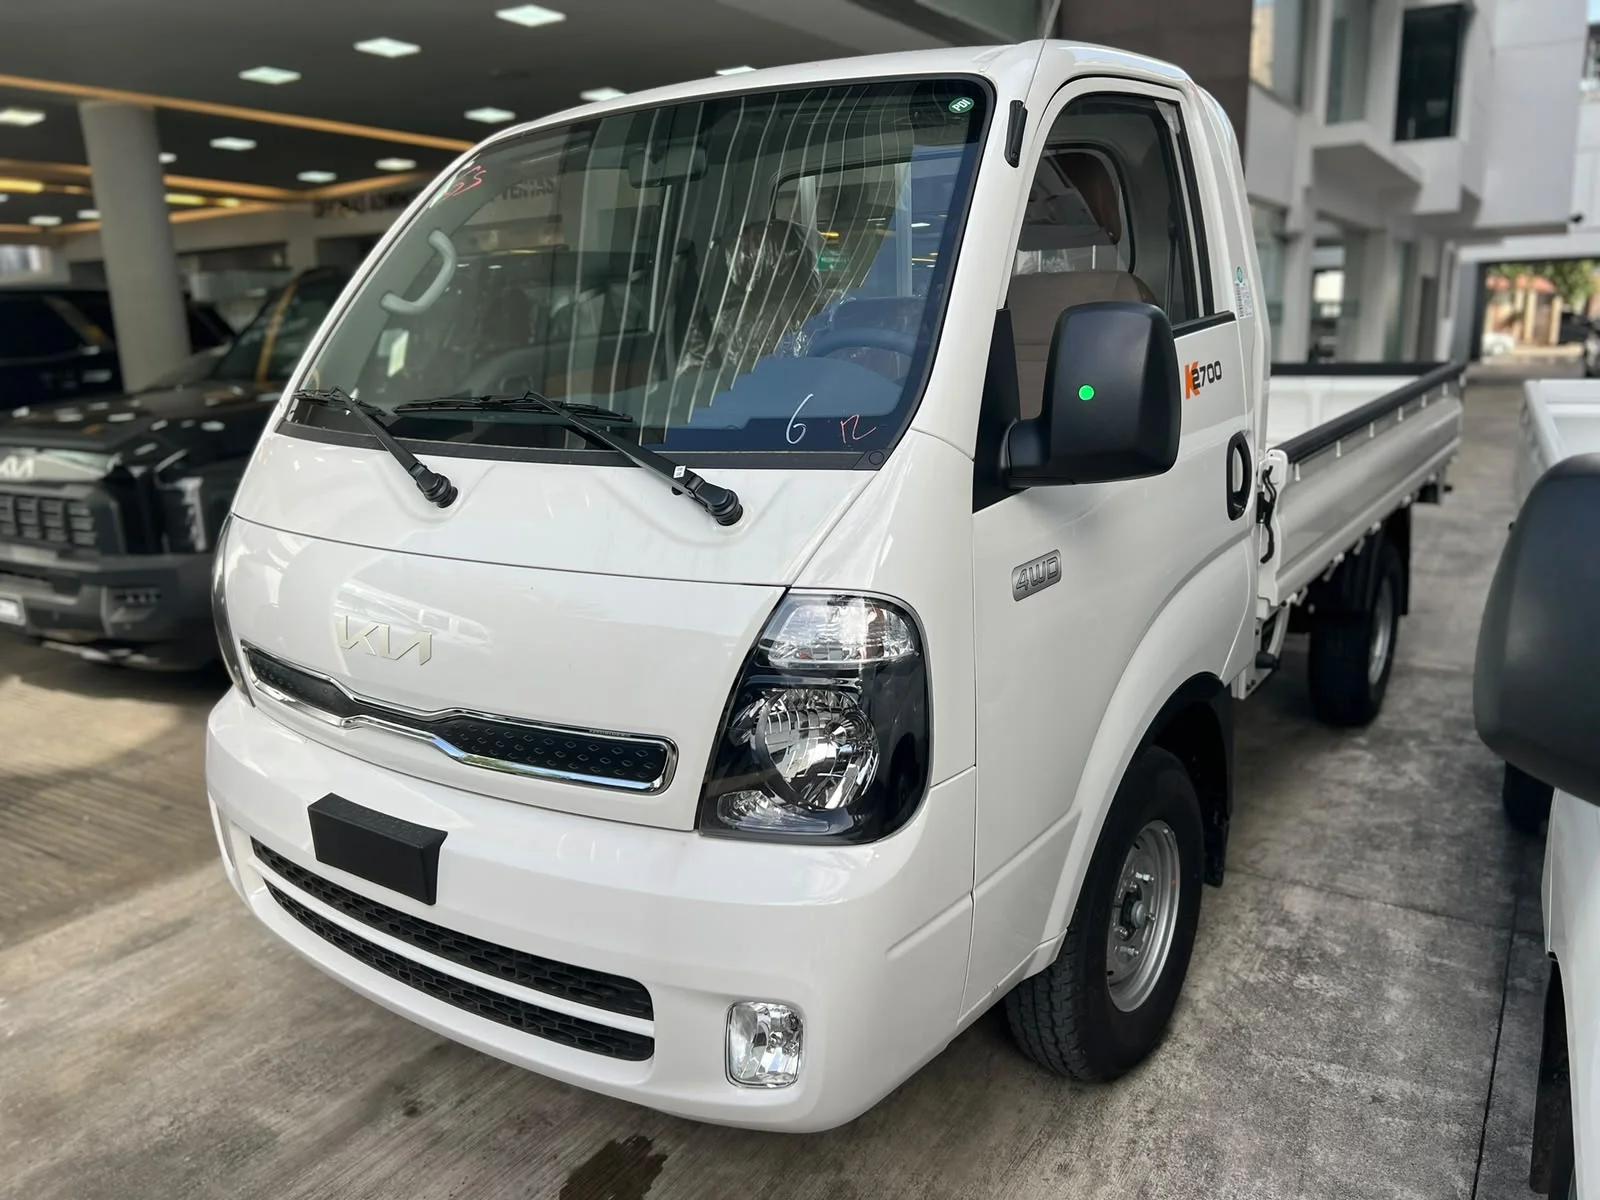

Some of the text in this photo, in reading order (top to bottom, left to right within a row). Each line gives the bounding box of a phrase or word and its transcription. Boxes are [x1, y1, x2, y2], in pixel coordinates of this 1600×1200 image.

[952, 98, 971, 111] PDI
[1184, 360, 1222, 400] K2700
[786, 393, 814, 444] 6
[1016, 556, 1058, 591] 4WD
[336, 615, 432, 666] KIA
